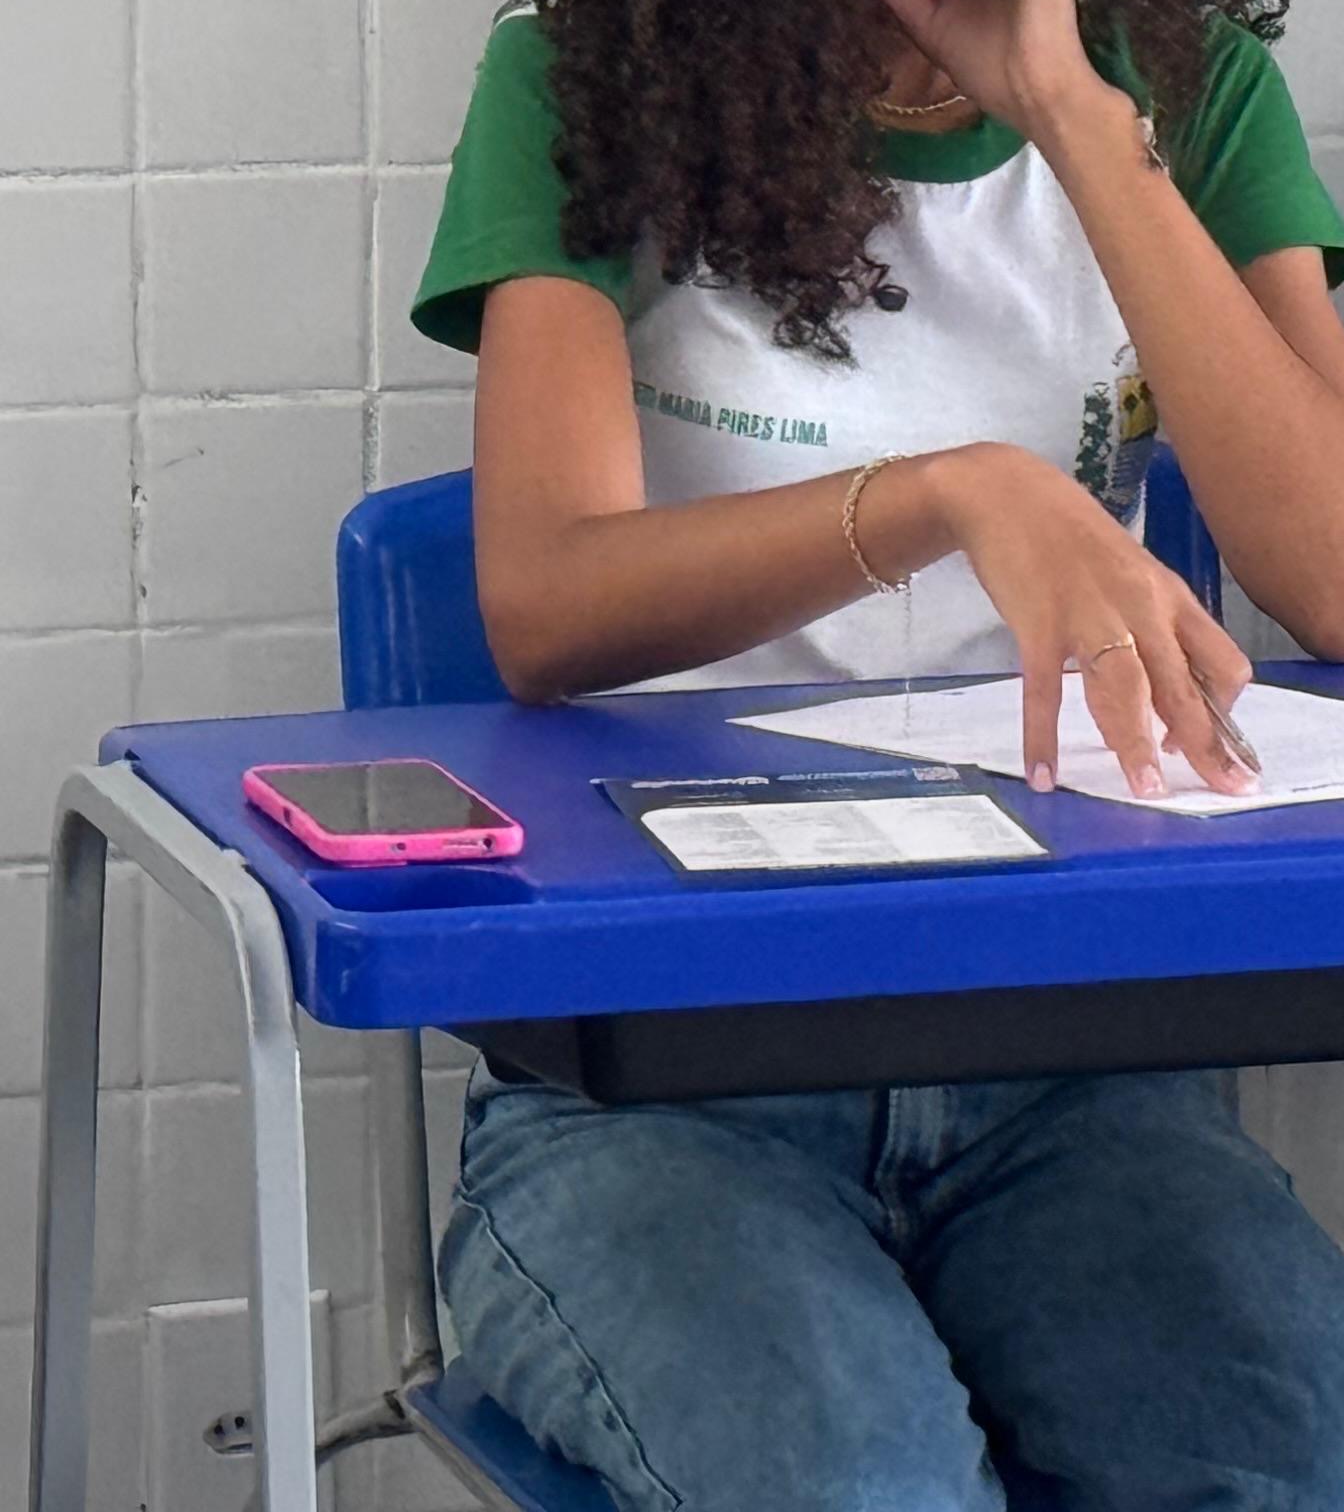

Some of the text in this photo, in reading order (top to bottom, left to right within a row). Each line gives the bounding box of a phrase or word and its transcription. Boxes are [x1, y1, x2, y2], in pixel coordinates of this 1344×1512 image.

[658, 391, 711, 427] MARIA
[717, 407, 774, 441] PIRES
[779, 418, 828, 447] LIMA
